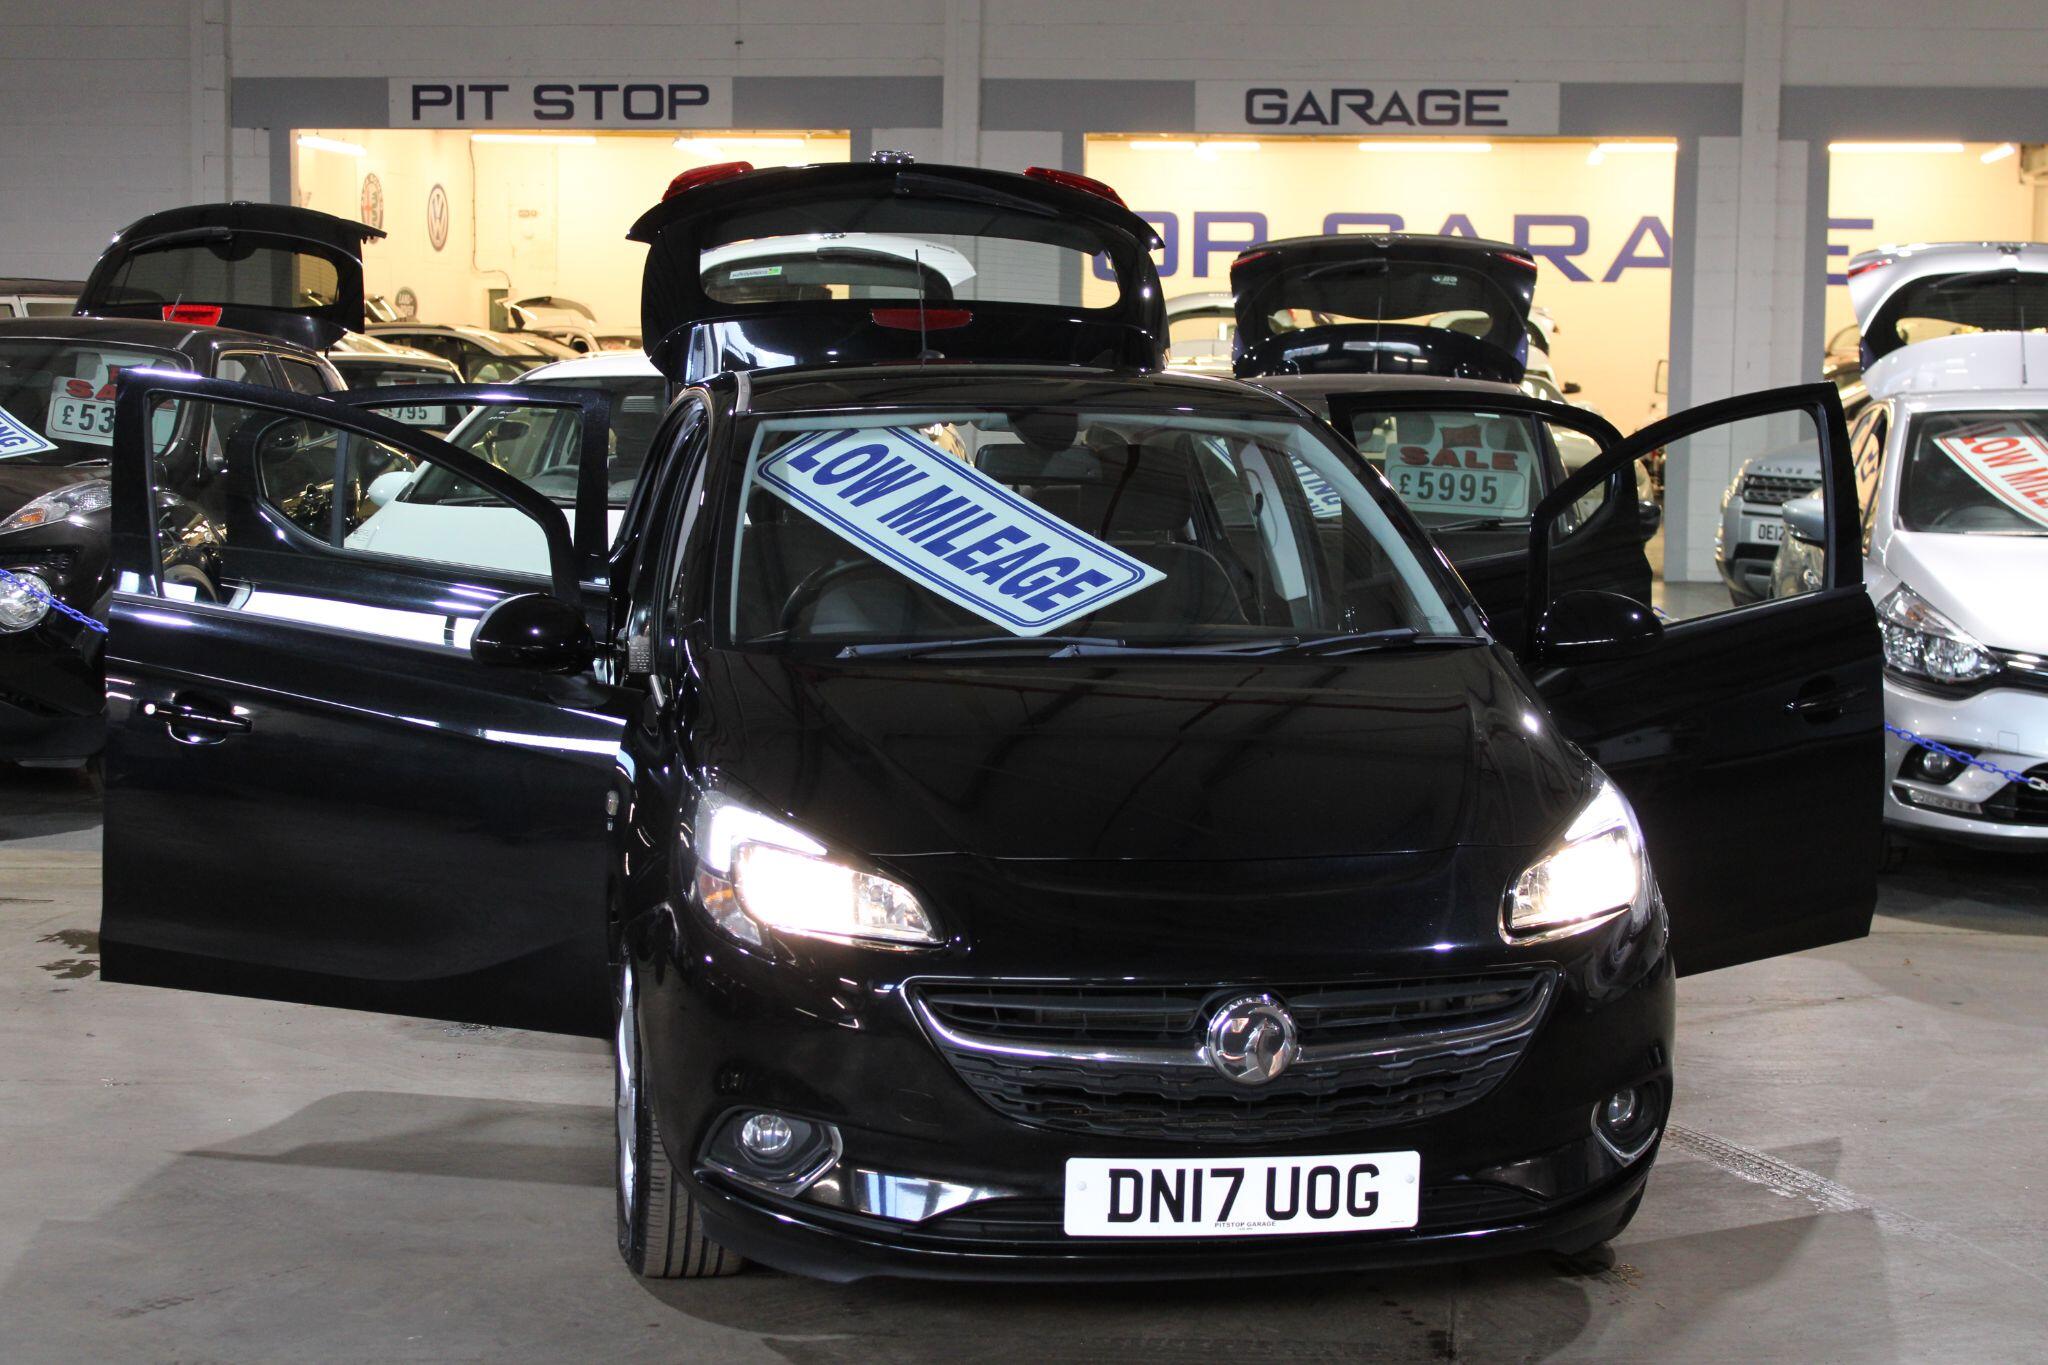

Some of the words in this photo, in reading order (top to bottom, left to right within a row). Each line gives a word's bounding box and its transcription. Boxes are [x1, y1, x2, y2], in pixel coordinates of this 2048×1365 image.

[412, 84, 509, 121] PIT
[533, 84, 710, 121] STOP
[1245, 88, 1509, 126] GARAGE
[1400, 446, 1519, 472] SALE
[1960, 426, 2039, 469] LOW
[1399, 471, 1498, 505] £5995
[786, 428, 930, 508] LOW
[877, 485, 1114, 613] MILEAGE
[1265, 1163, 1380, 1220] UOG
